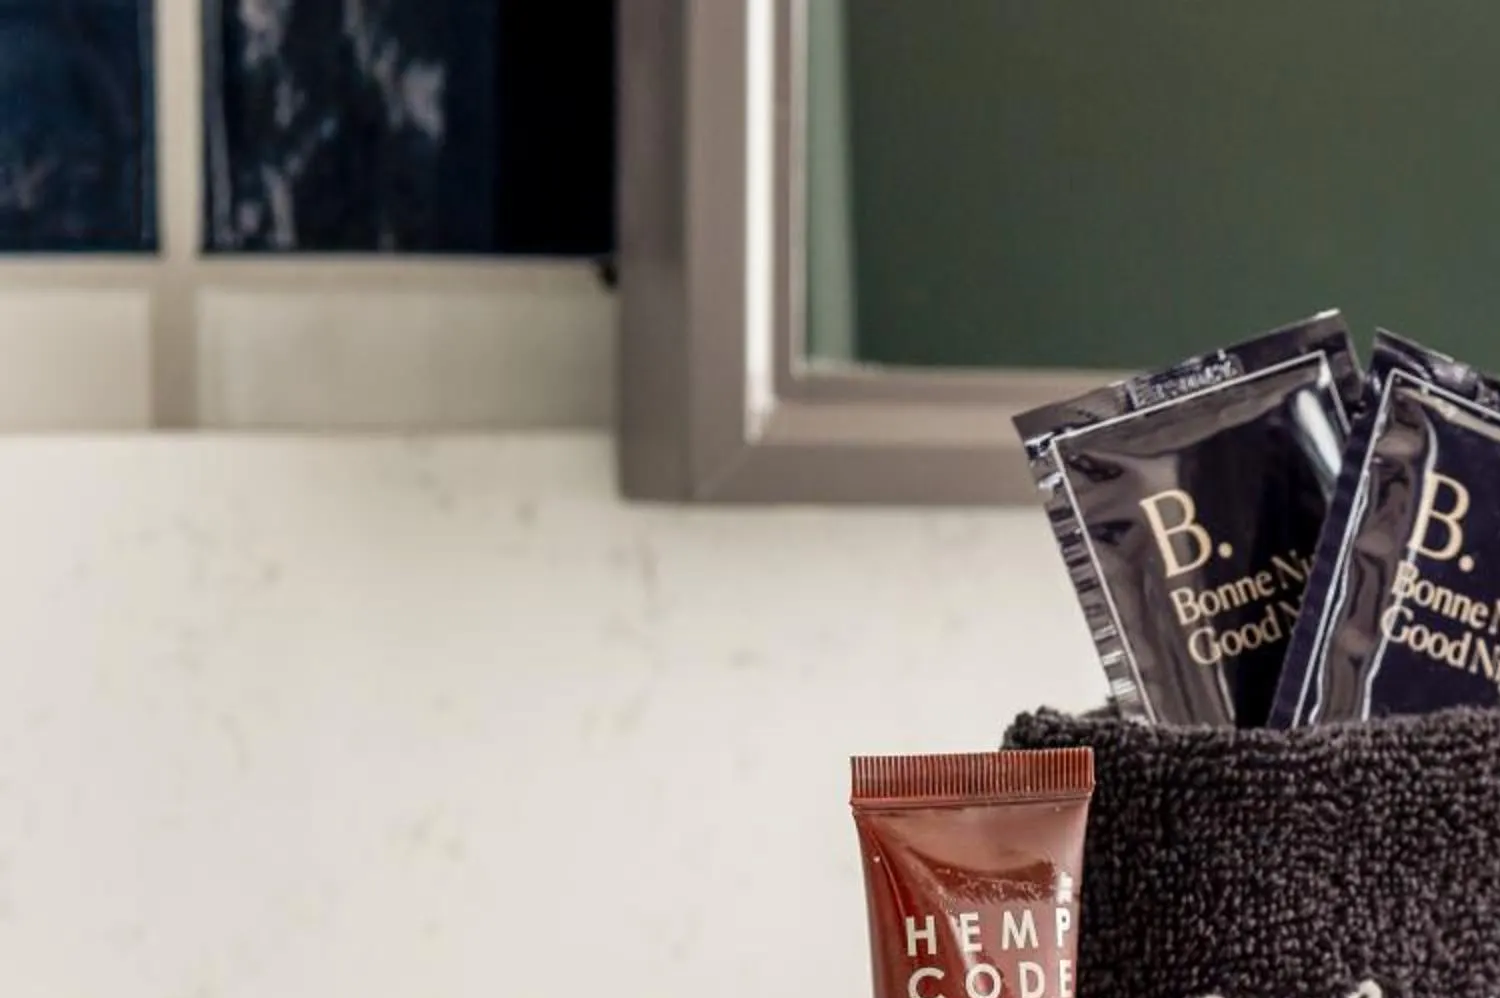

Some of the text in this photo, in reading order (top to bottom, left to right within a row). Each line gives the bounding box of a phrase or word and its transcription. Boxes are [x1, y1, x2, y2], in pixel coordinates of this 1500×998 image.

[1139, 488, 1233, 578] B.
[1407, 471, 1475, 572] B.
[1169, 571, 1275, 625] Bonne
[1270, 549, 1316, 590] Nu
[1391, 560, 1489, 629] Bonne
[1188, 604, 1283, 665] Good
[1380, 604, 1473, 669] Good
[905, 907, 1072, 956] HEMP
